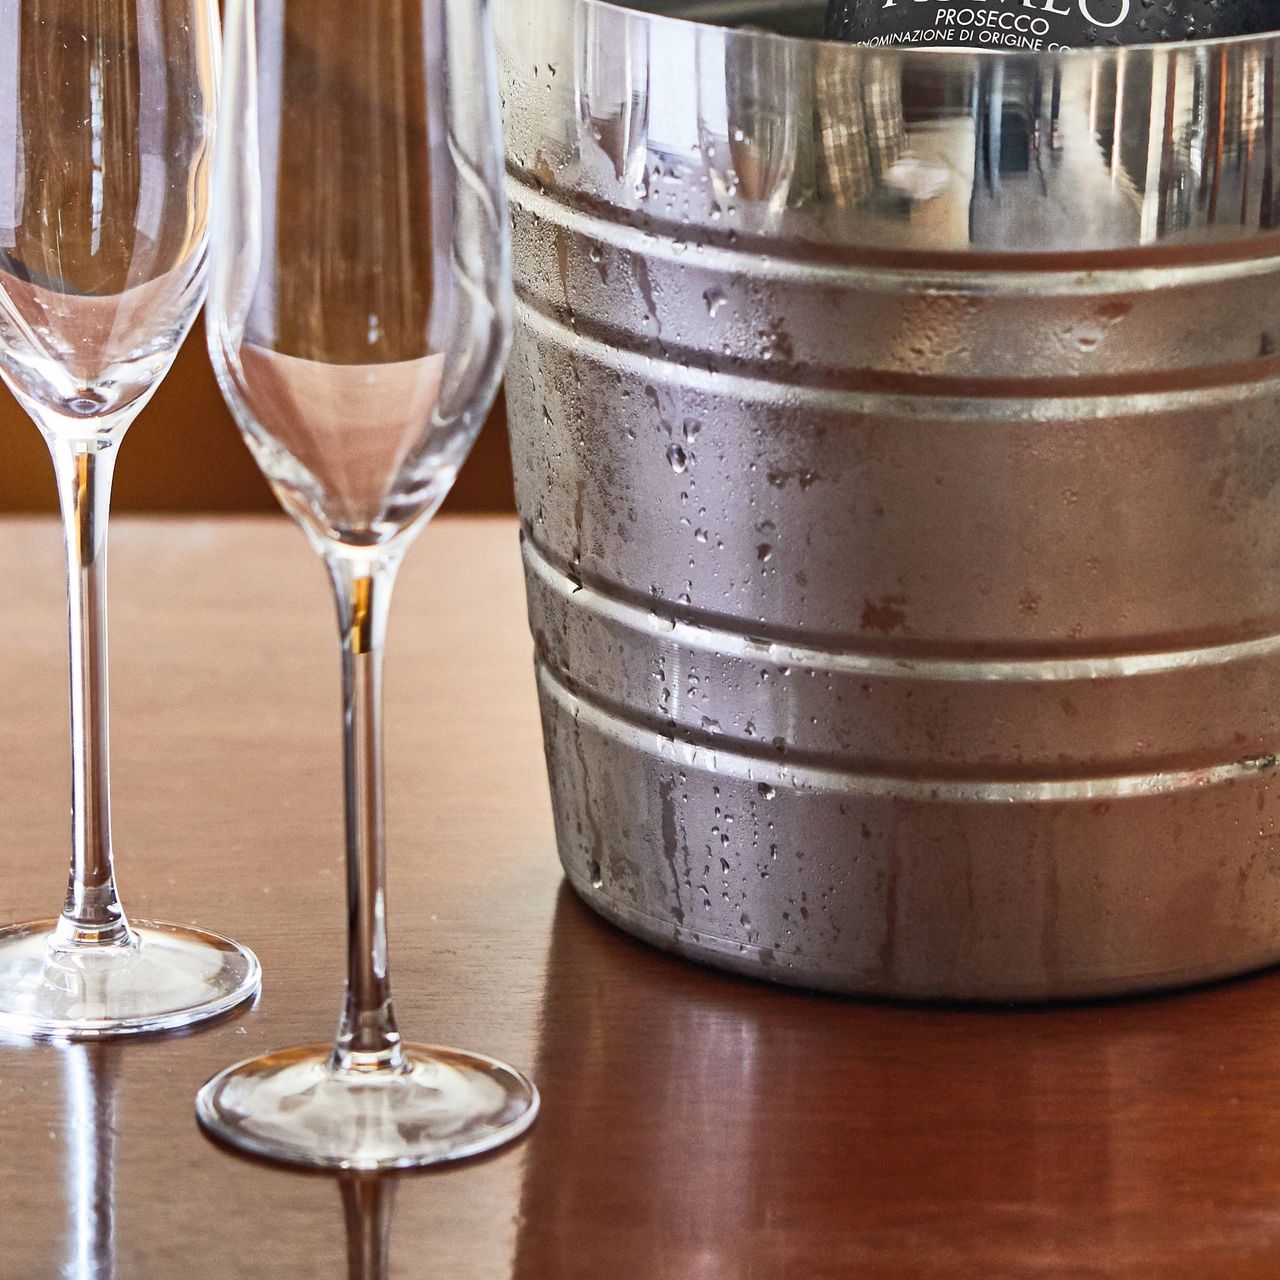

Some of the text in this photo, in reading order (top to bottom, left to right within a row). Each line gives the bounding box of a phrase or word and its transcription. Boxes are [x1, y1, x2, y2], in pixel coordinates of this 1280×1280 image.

[934, 8, 1050, 36] PROSECCO
[851, 29, 956, 49] ENOMINAZIONE
[959, 29, 975, 42] DI
[978, 30, 1044, 52] ORIGINE
